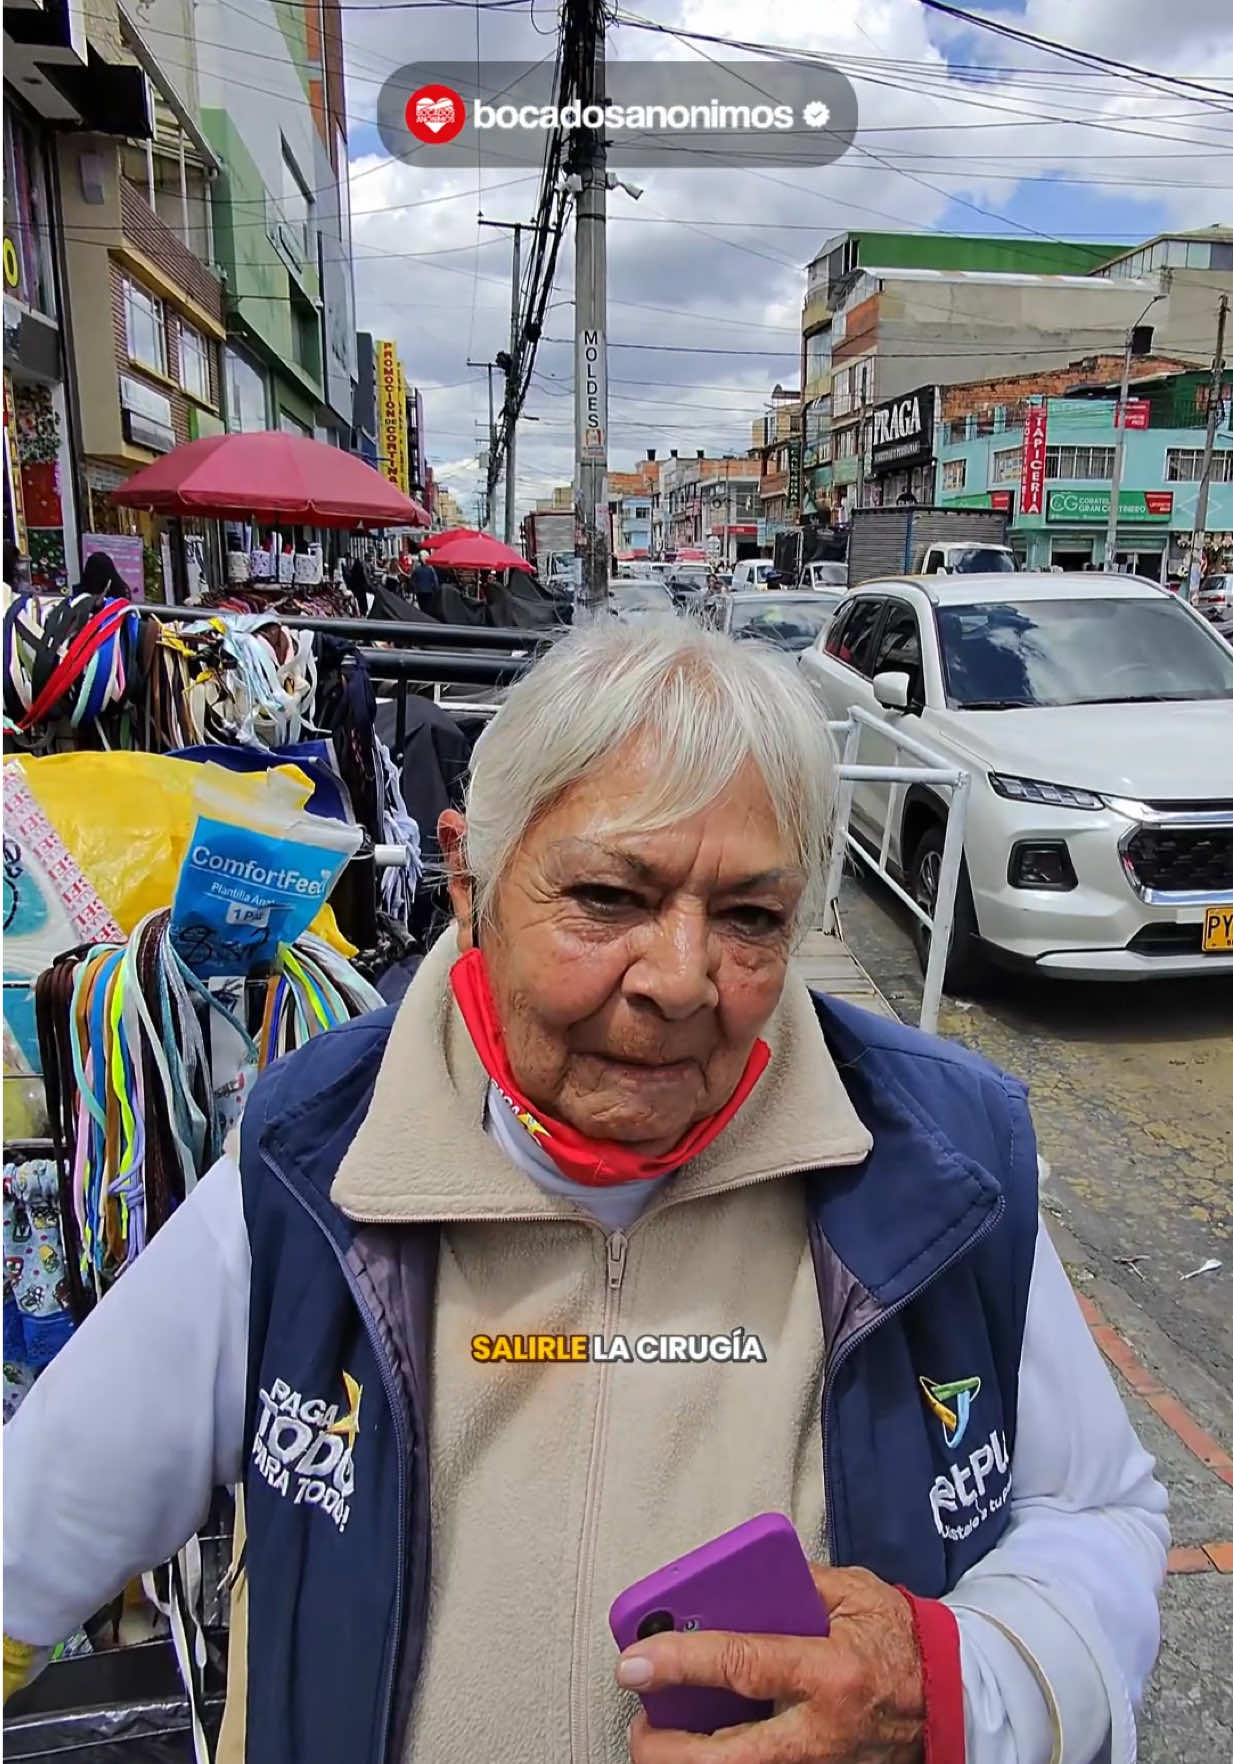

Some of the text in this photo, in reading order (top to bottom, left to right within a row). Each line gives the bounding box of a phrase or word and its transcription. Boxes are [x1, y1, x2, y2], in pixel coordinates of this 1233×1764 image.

[584, 330, 600, 428] MOLDES
[873, 396, 921, 445] PRAGA
[1079, 504, 1100, 513] GRAN
[211, 881, 250, 902] Plantilla
[233, 908, 241, 920] 1
[270, 1377, 339, 1430] PAGA
[252, 1432, 290, 1497] PARA
[259, 1388, 355, 1498] TODO
